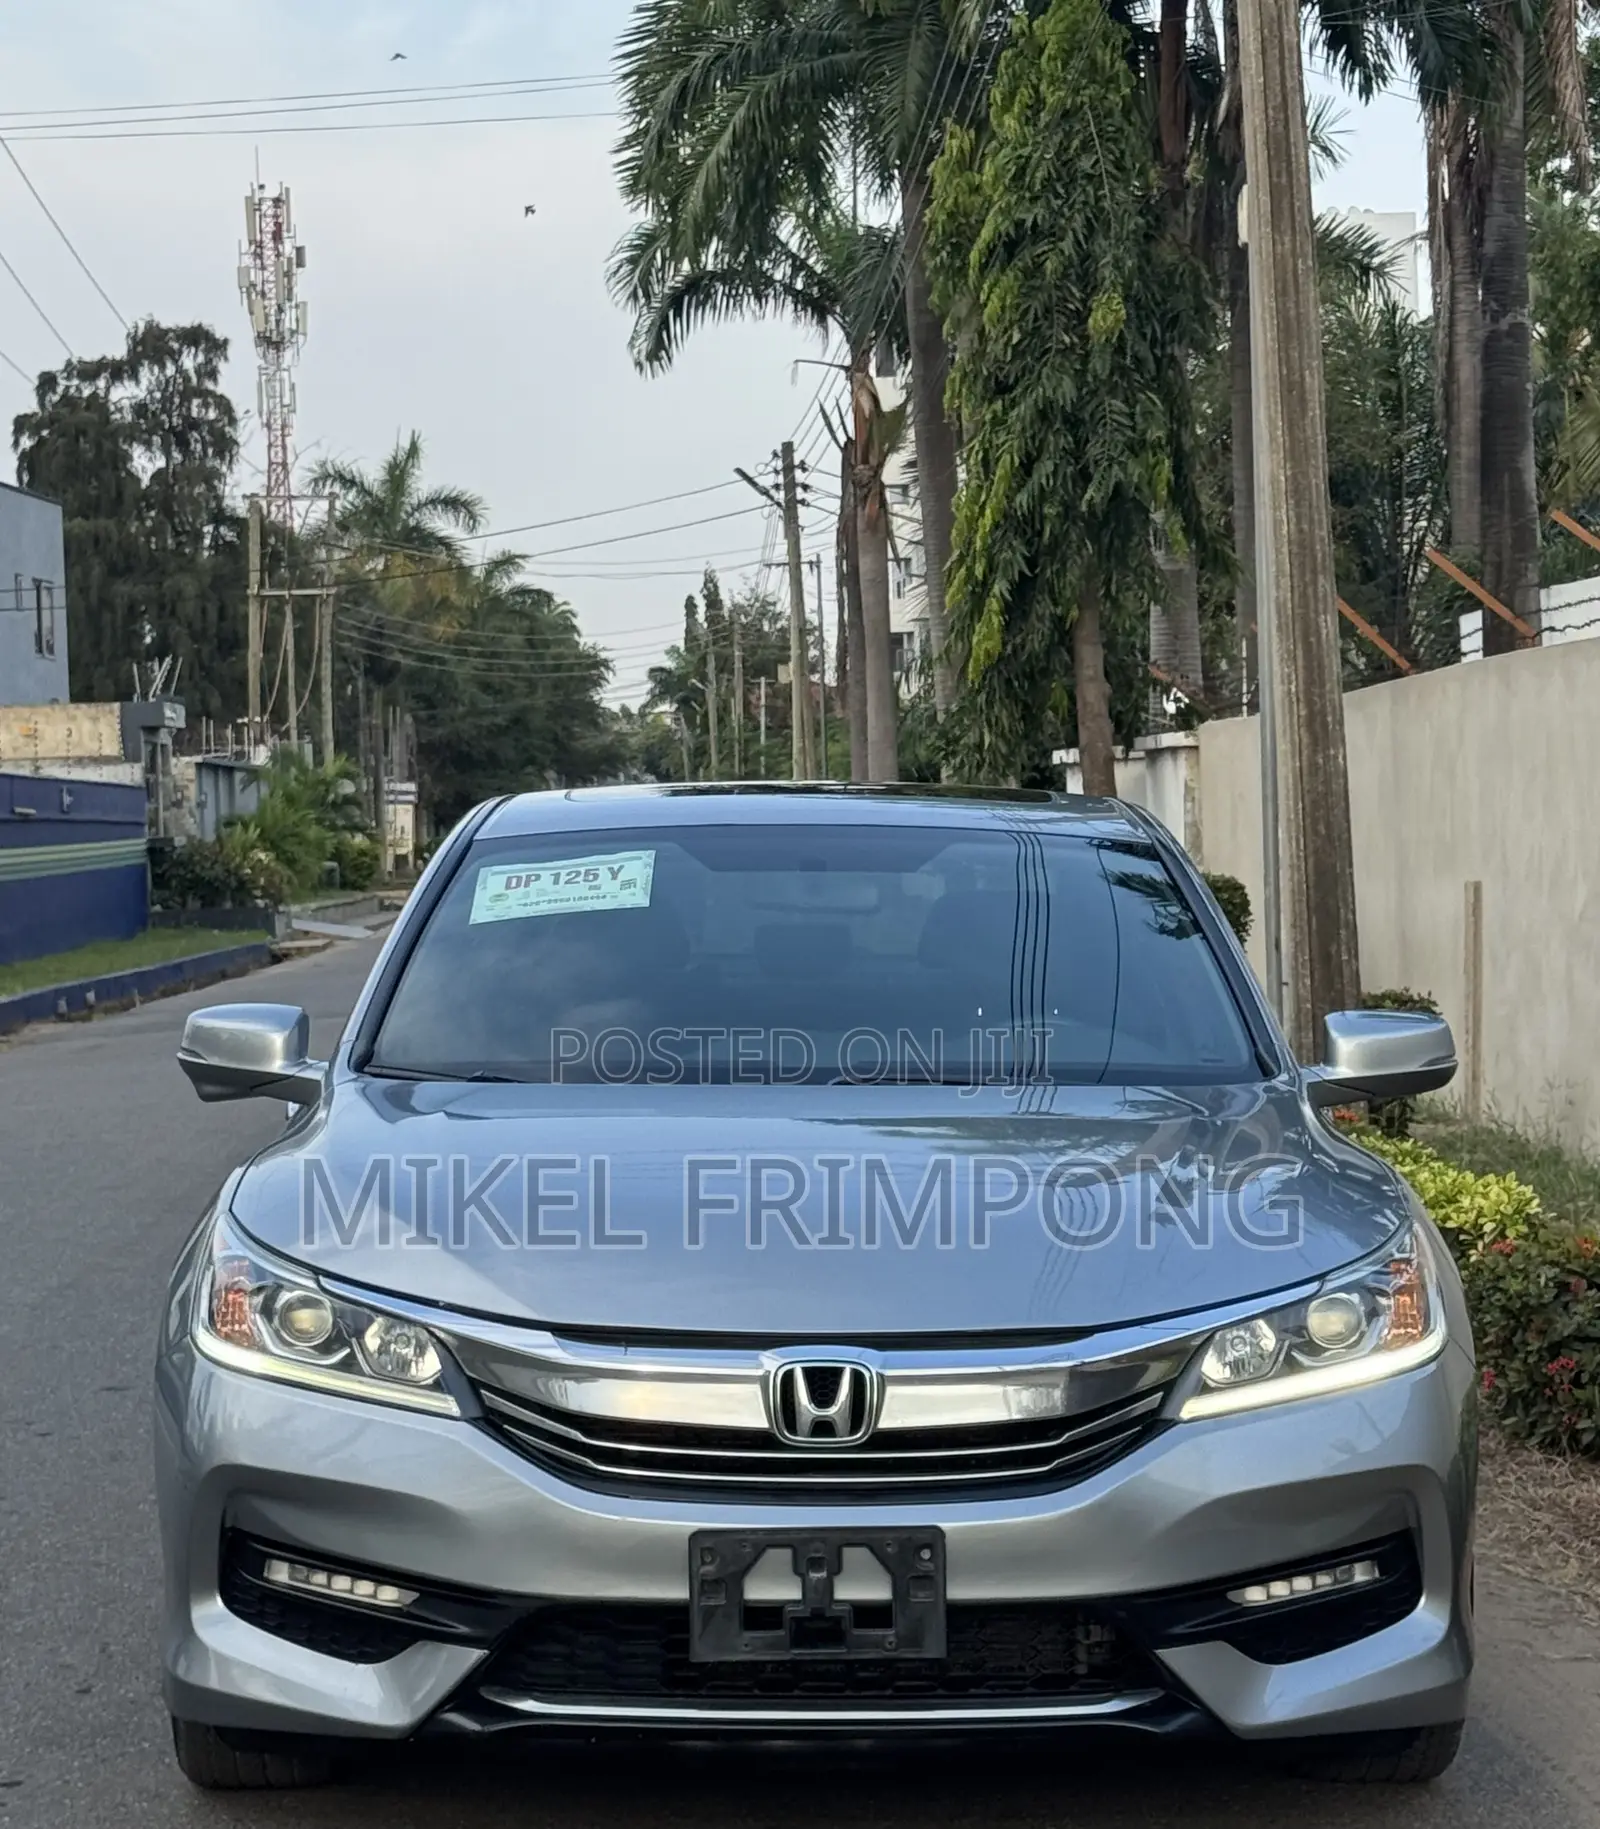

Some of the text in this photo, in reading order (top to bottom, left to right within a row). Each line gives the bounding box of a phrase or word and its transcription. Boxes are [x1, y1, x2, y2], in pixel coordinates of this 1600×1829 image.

[504, 873, 541, 891] DP
[550, 868, 600, 886] 125
[607, 865, 625, 880] Y
